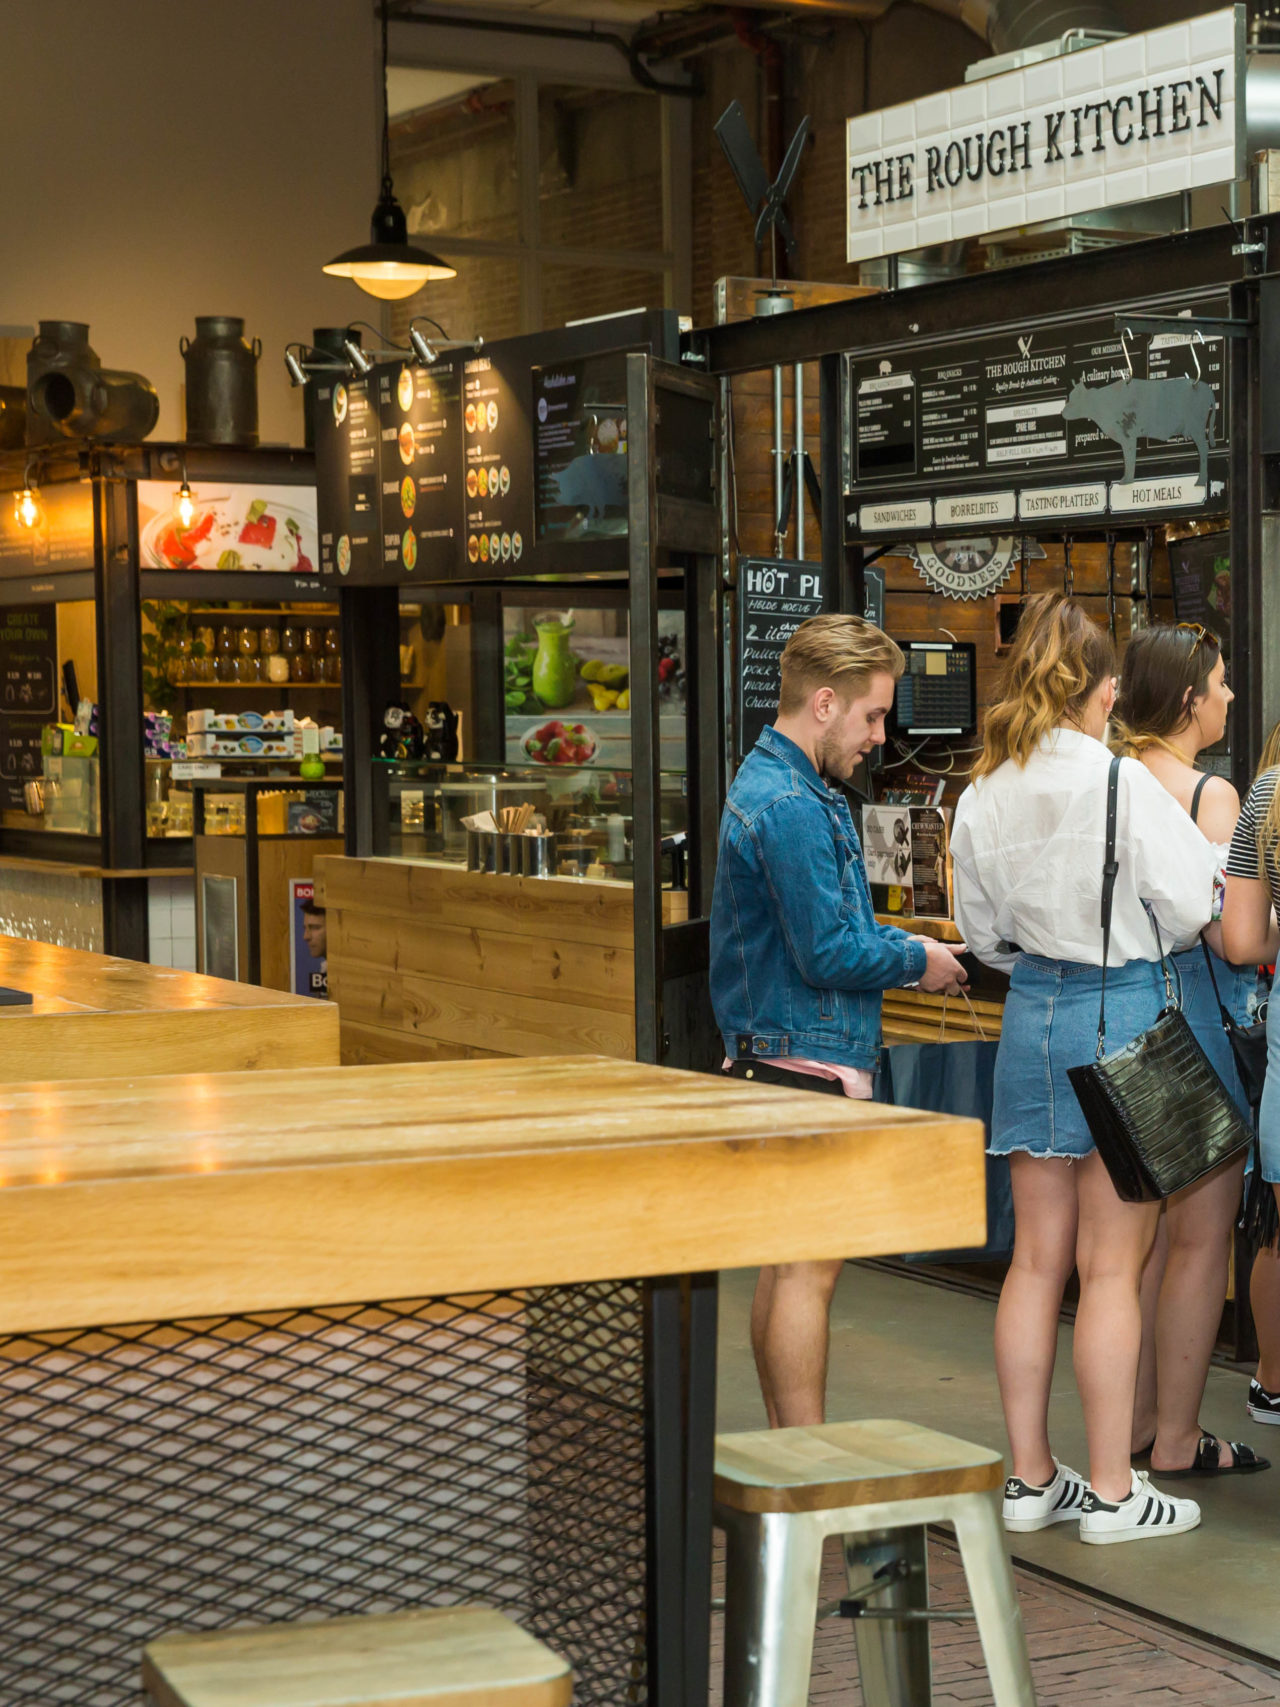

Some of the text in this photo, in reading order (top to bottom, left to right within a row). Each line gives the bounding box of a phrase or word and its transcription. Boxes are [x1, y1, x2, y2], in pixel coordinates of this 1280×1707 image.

[852, 69, 1224, 209] THE ROUGH KITCHEN
[985, 354, 1066, 378] THE ROUGH KITCHEN
[1087, 369, 1110, 383] culinary
[1110, 366, 1131, 381] homag
[1075, 428, 1100, 446] prepared
[1026, 492, 1099, 512] TASTING PLATTERS
[1132, 486, 1182, 504] HOT MEALS
[873, 508, 917, 525] SANDWICHES
[950, 501, 999, 519] BORRELBITES
[926, 556, 1004, 588] GOODNESS
[747, 568, 789, 595] HOT
[746, 624, 793, 641] 2 item
